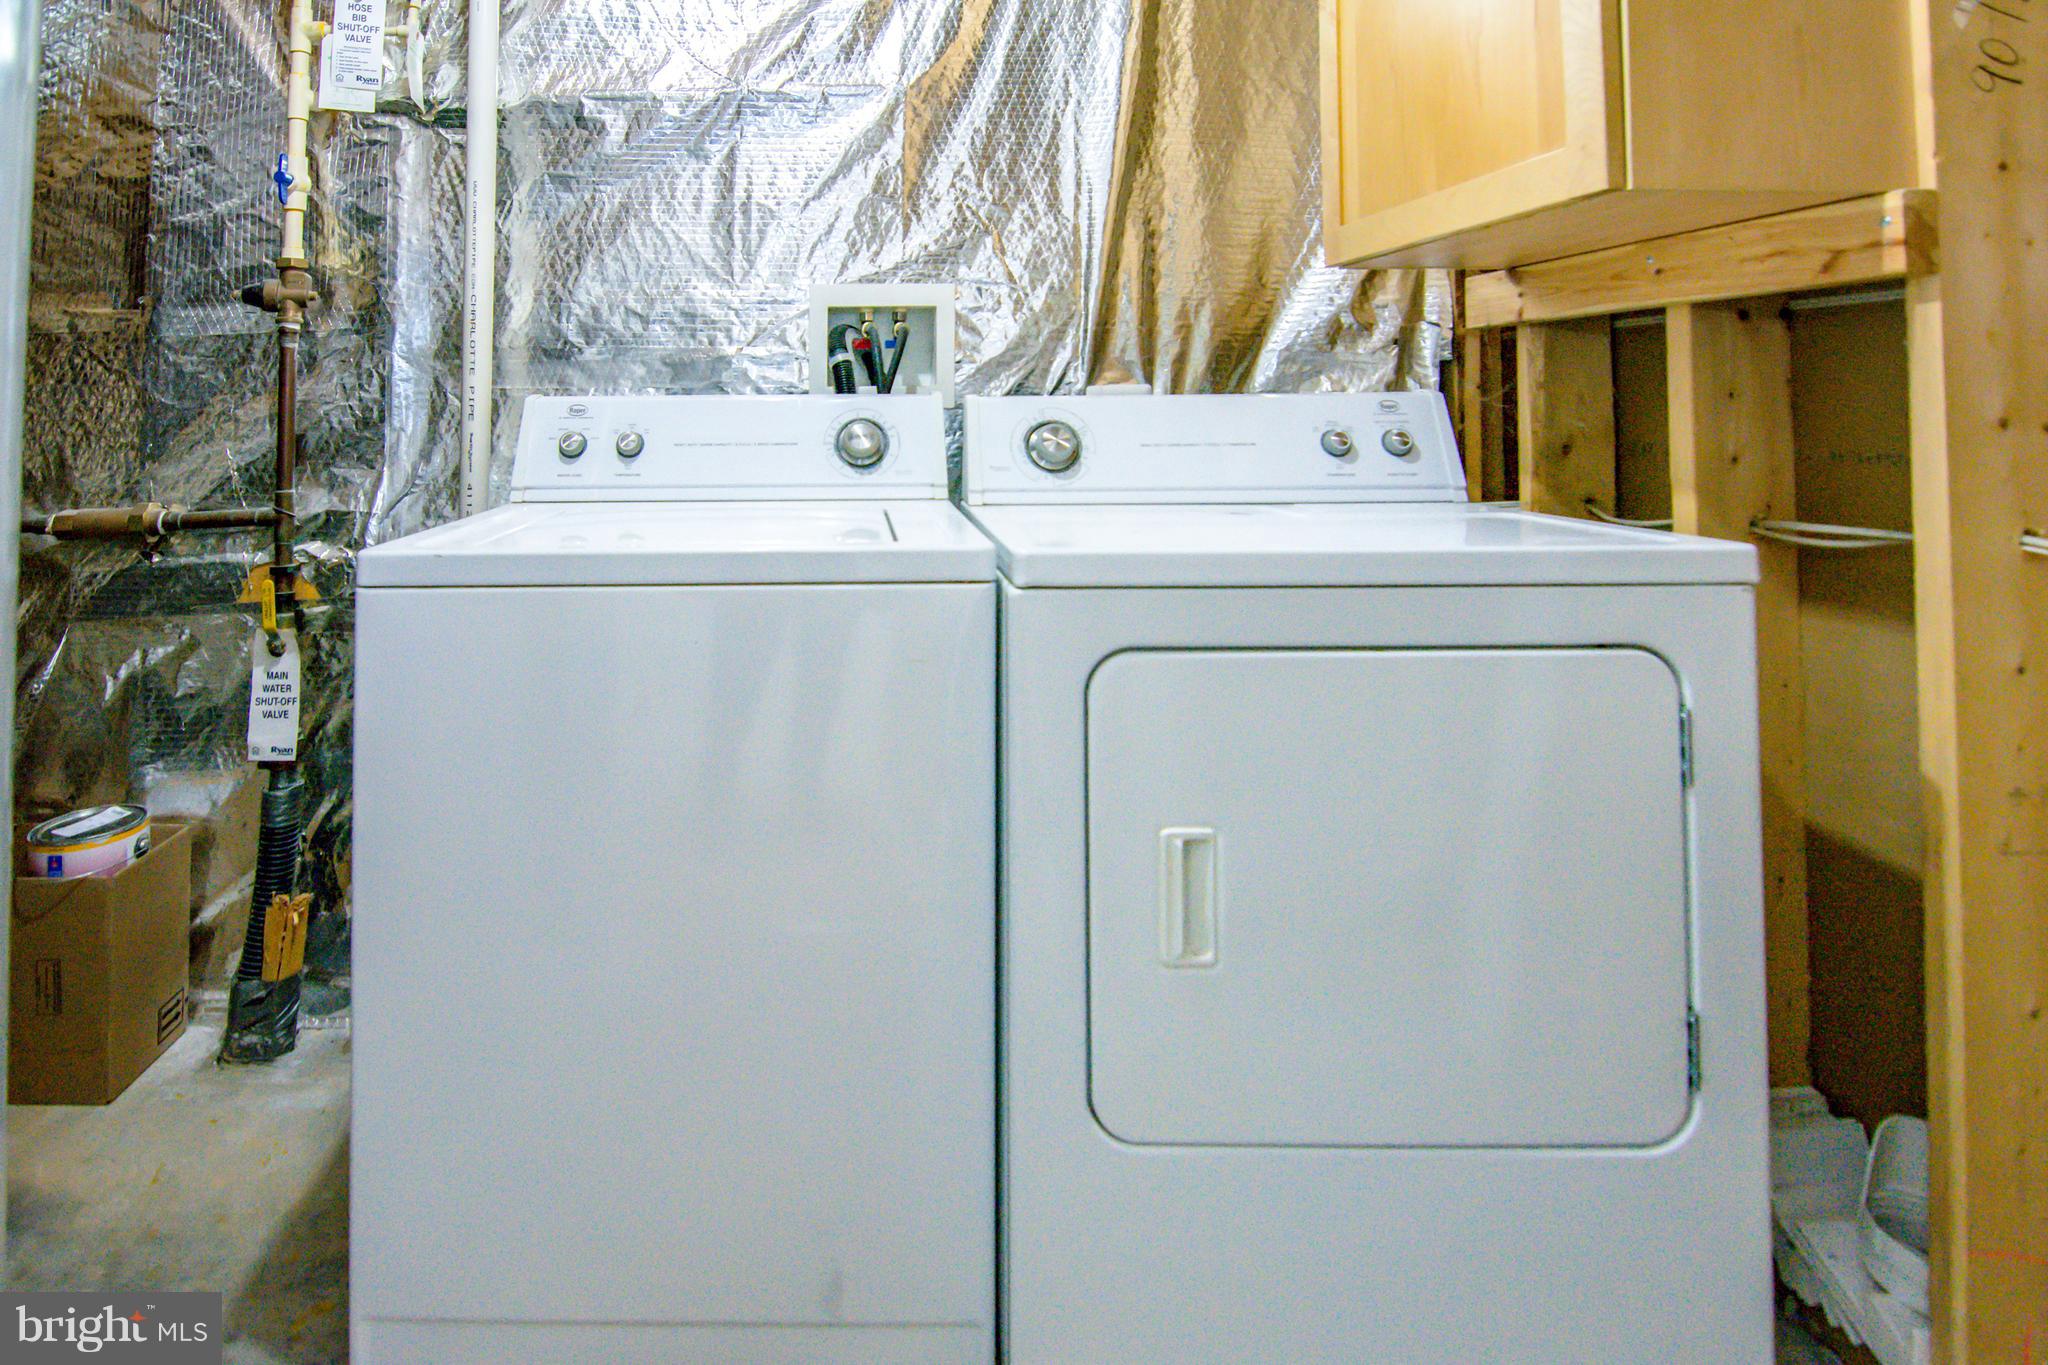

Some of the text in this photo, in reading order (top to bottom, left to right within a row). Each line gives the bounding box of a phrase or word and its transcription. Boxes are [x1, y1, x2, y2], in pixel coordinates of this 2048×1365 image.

[348, 3, 373, 13] HOSE
[352, 13, 367, 22] BIB
[337, 22, 380, 34] SHUT-OFF
[345, 34, 372, 44] VALVE
[356, 75, 379, 84] Ryan
[469, 294, 477, 376] CHARLOTTE
[266, 671, 289, 680] MAIN
[262, 684, 292, 693] WATER
[255, 697, 297, 706] SHUT-OFF
[262, 710, 289, 719] VALVE
[270, 746, 294, 755] Ryan
